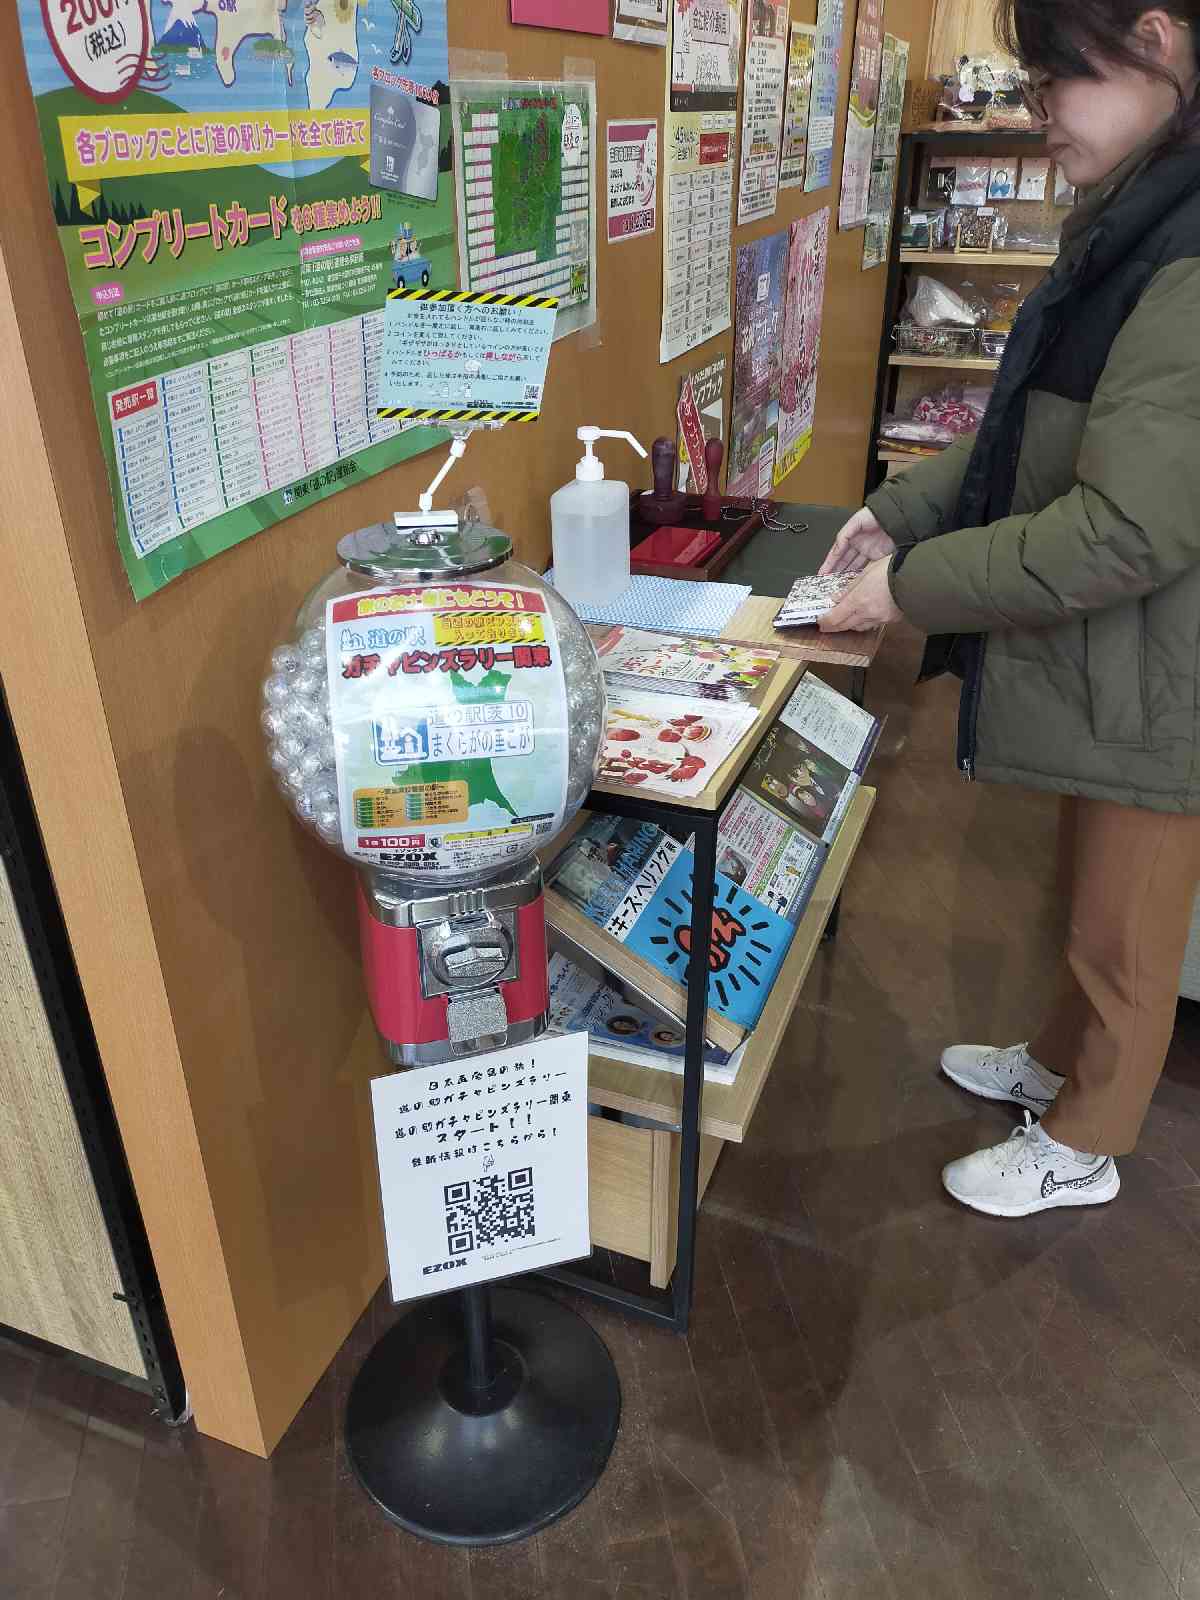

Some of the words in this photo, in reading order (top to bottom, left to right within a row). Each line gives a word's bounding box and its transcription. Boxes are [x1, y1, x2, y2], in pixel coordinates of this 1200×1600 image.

[85, 20, 126, 62] (税込)
[79, 194, 288, 269] コンプリートカード
[431, 727, 531, 757] まくらがの里こが
[380, 852, 437, 862] EZOX
[607, 849, 670, 936] キース・ヘリング
[422, 1257, 468, 1276] EZOX
